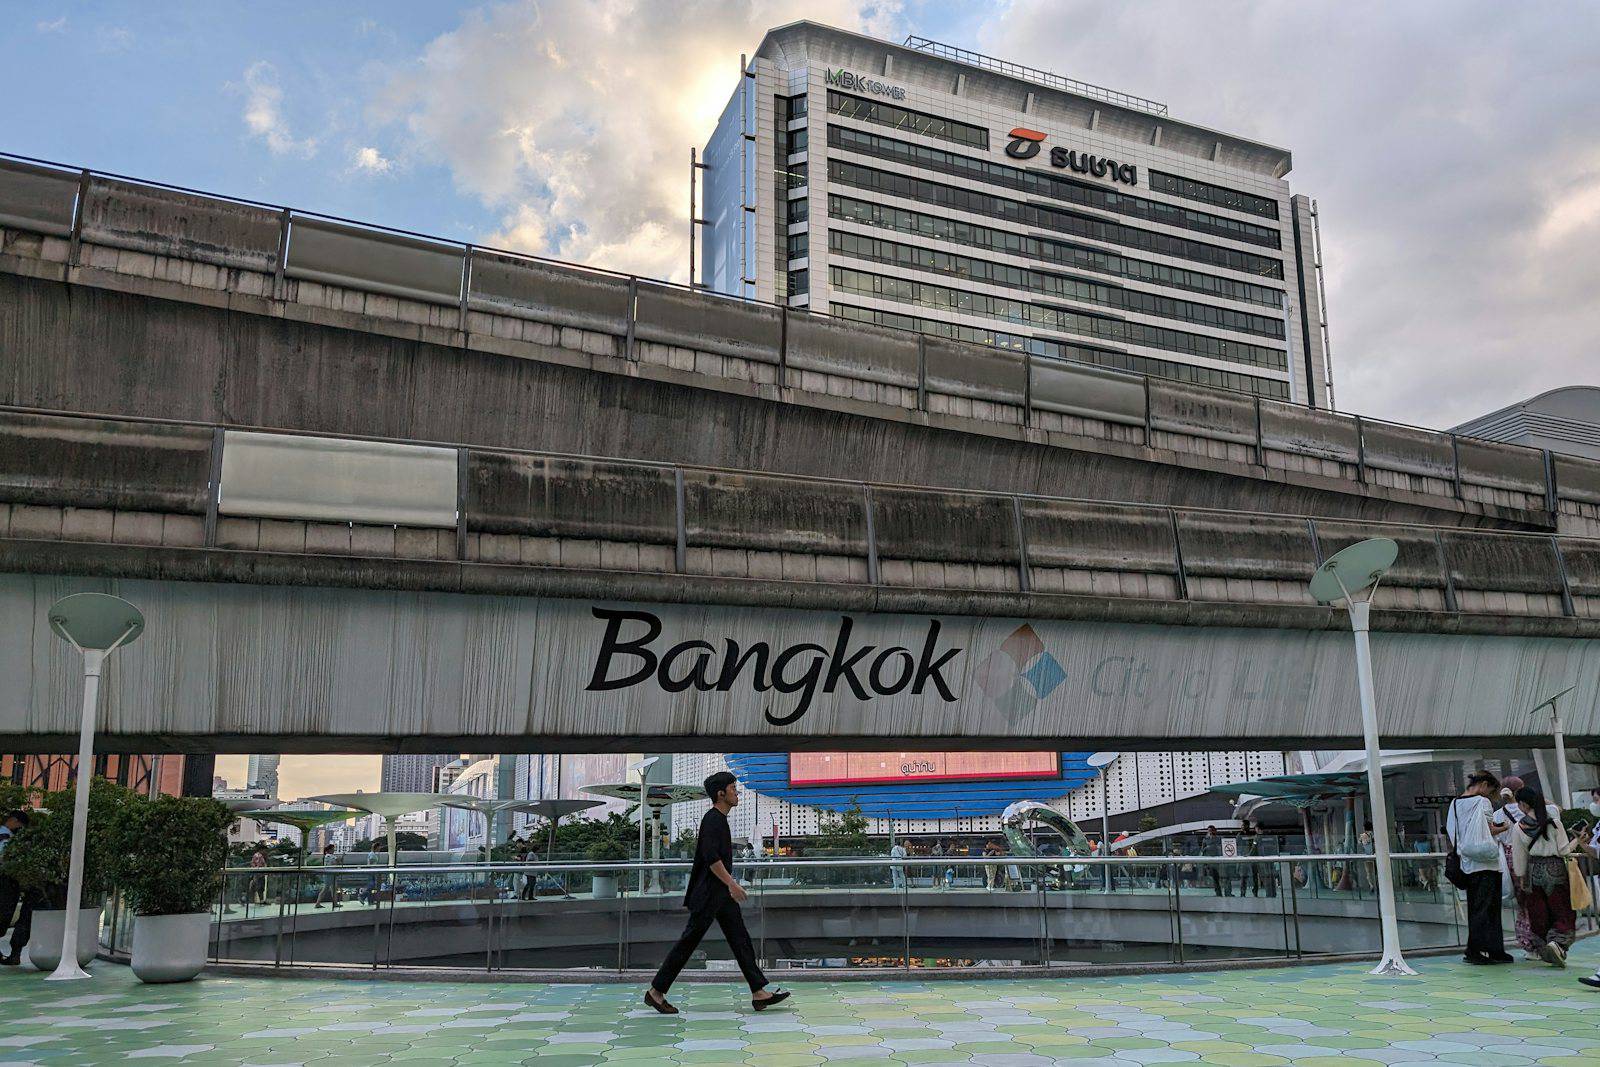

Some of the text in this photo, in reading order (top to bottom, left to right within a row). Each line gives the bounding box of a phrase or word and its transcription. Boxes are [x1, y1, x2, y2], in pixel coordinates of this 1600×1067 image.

[825, 67, 906, 100] MBK TOWER
[1051, 147, 1137, 186] ธนชาต
[585, 606, 963, 726] Bangkok
